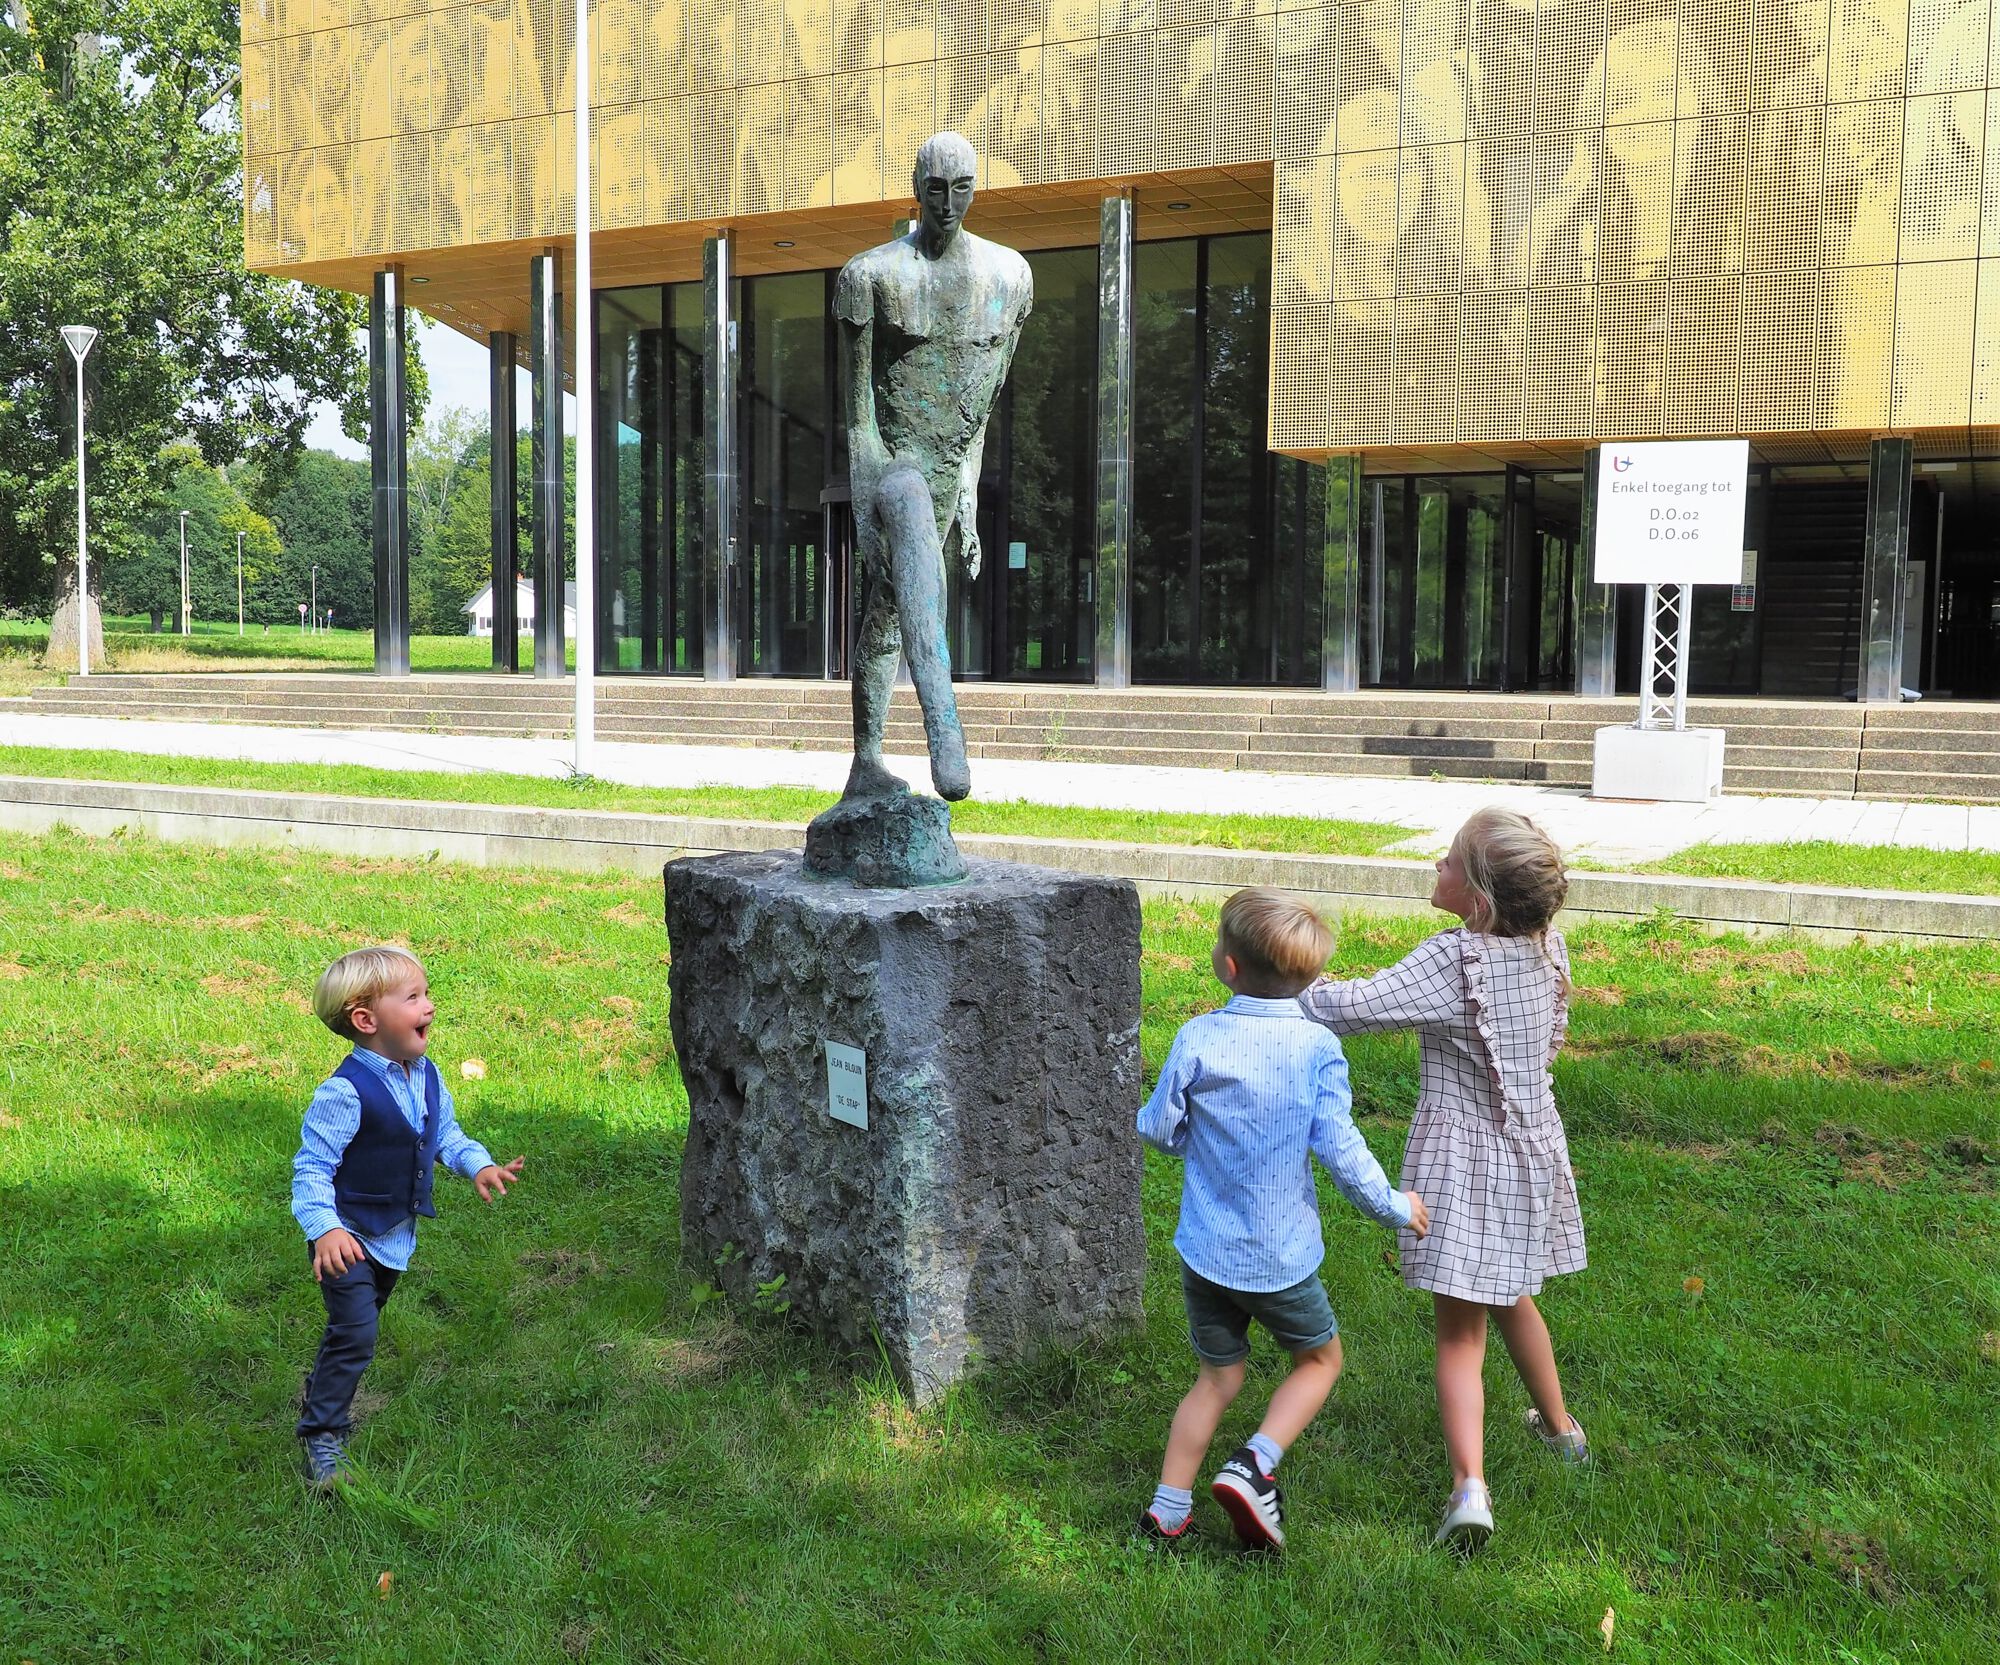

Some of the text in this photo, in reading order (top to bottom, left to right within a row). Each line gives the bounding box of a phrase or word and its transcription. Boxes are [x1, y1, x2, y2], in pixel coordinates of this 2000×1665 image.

[1612, 481, 1732, 495] Enkel toegang tot
[831, 1057, 843, 1069] JEAN
